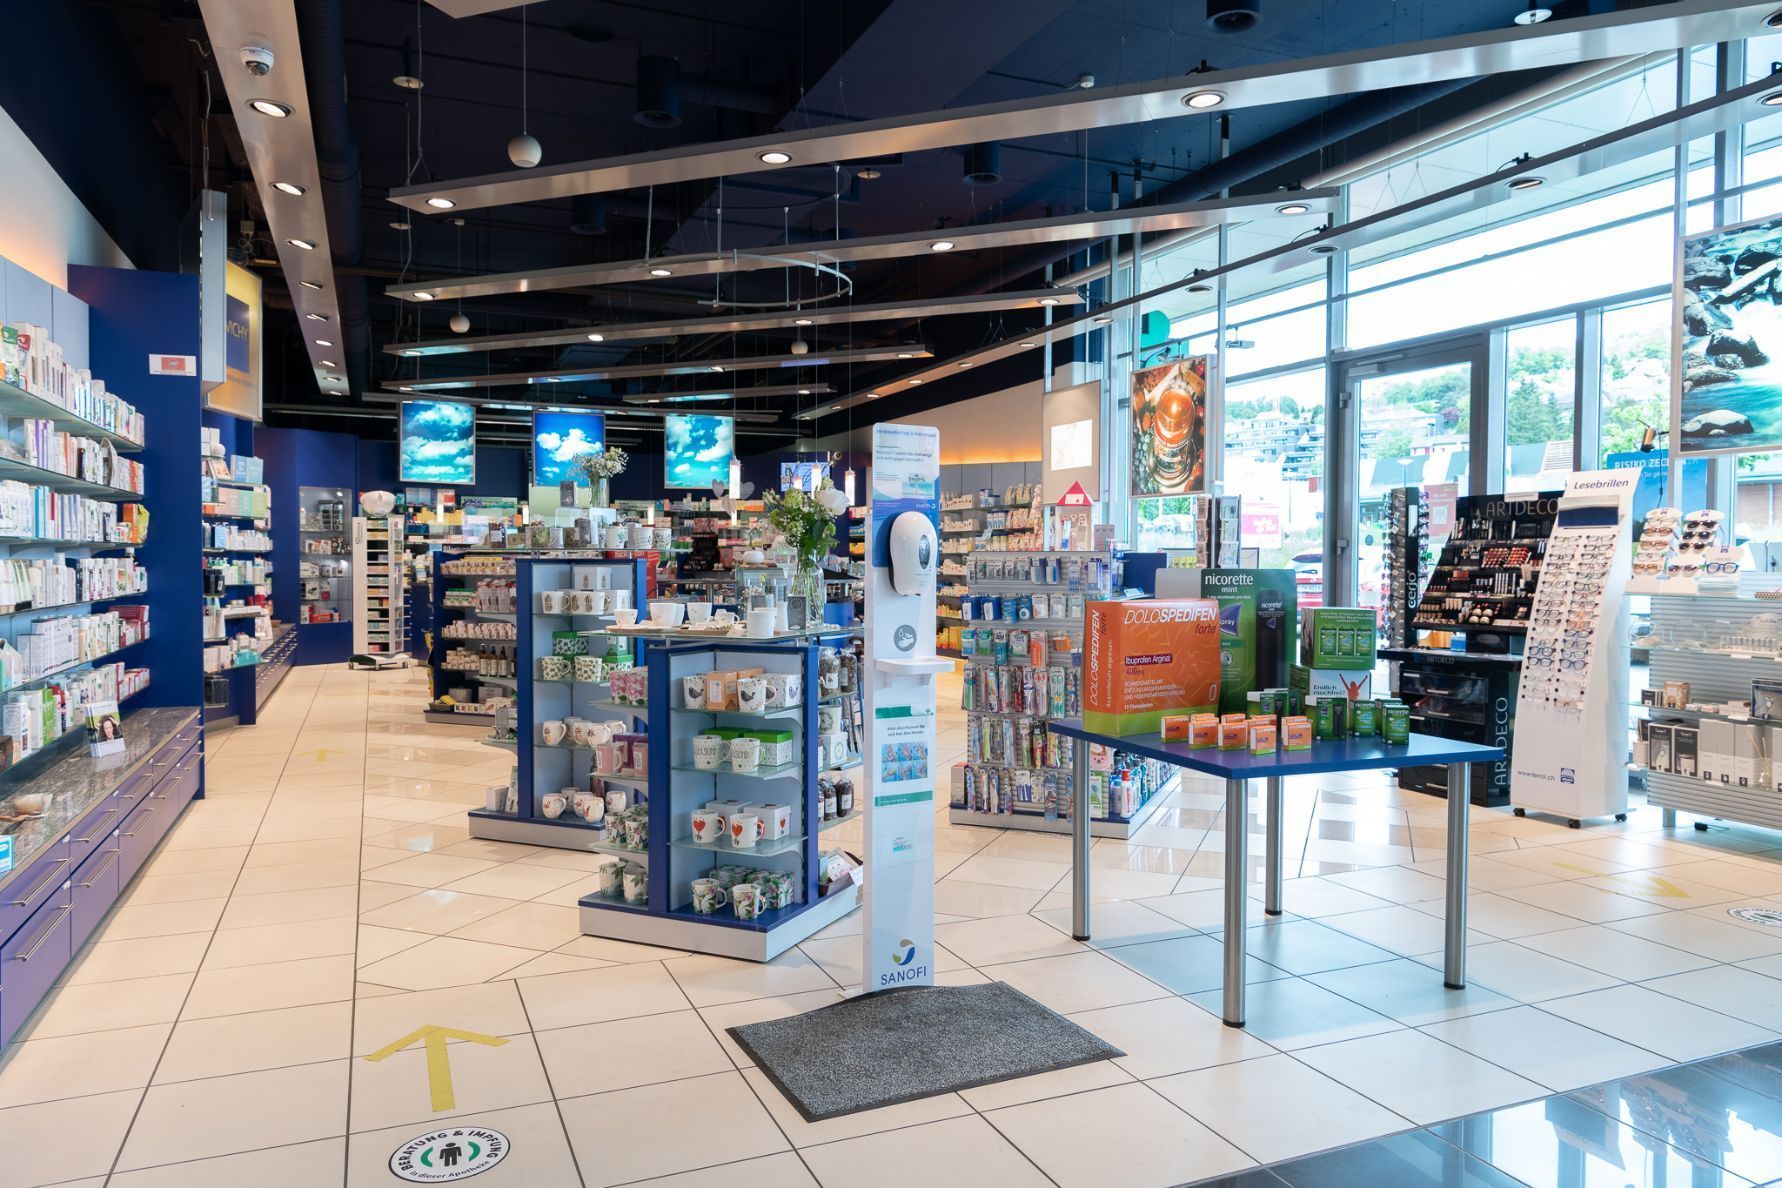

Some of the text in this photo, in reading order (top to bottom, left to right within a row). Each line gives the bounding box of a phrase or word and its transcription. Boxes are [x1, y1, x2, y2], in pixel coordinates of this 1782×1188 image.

[1614, 460, 1646, 469] RISIKO
[1573, 479, 1629, 490] Lesebrillen
[1486, 498, 1559, 517] ARTDECO
[1205, 573, 1254, 585] nicorette
[1195, 623, 1217, 634] forte
[1427, 656, 1455, 664] ARTDECO
[1494, 697, 1509, 785] ARDECO
[880, 966, 927, 986] SANOFI
[398, 1132, 447, 1171] BERATUNG
[468, 1130, 502, 1159] IMPFUNG
